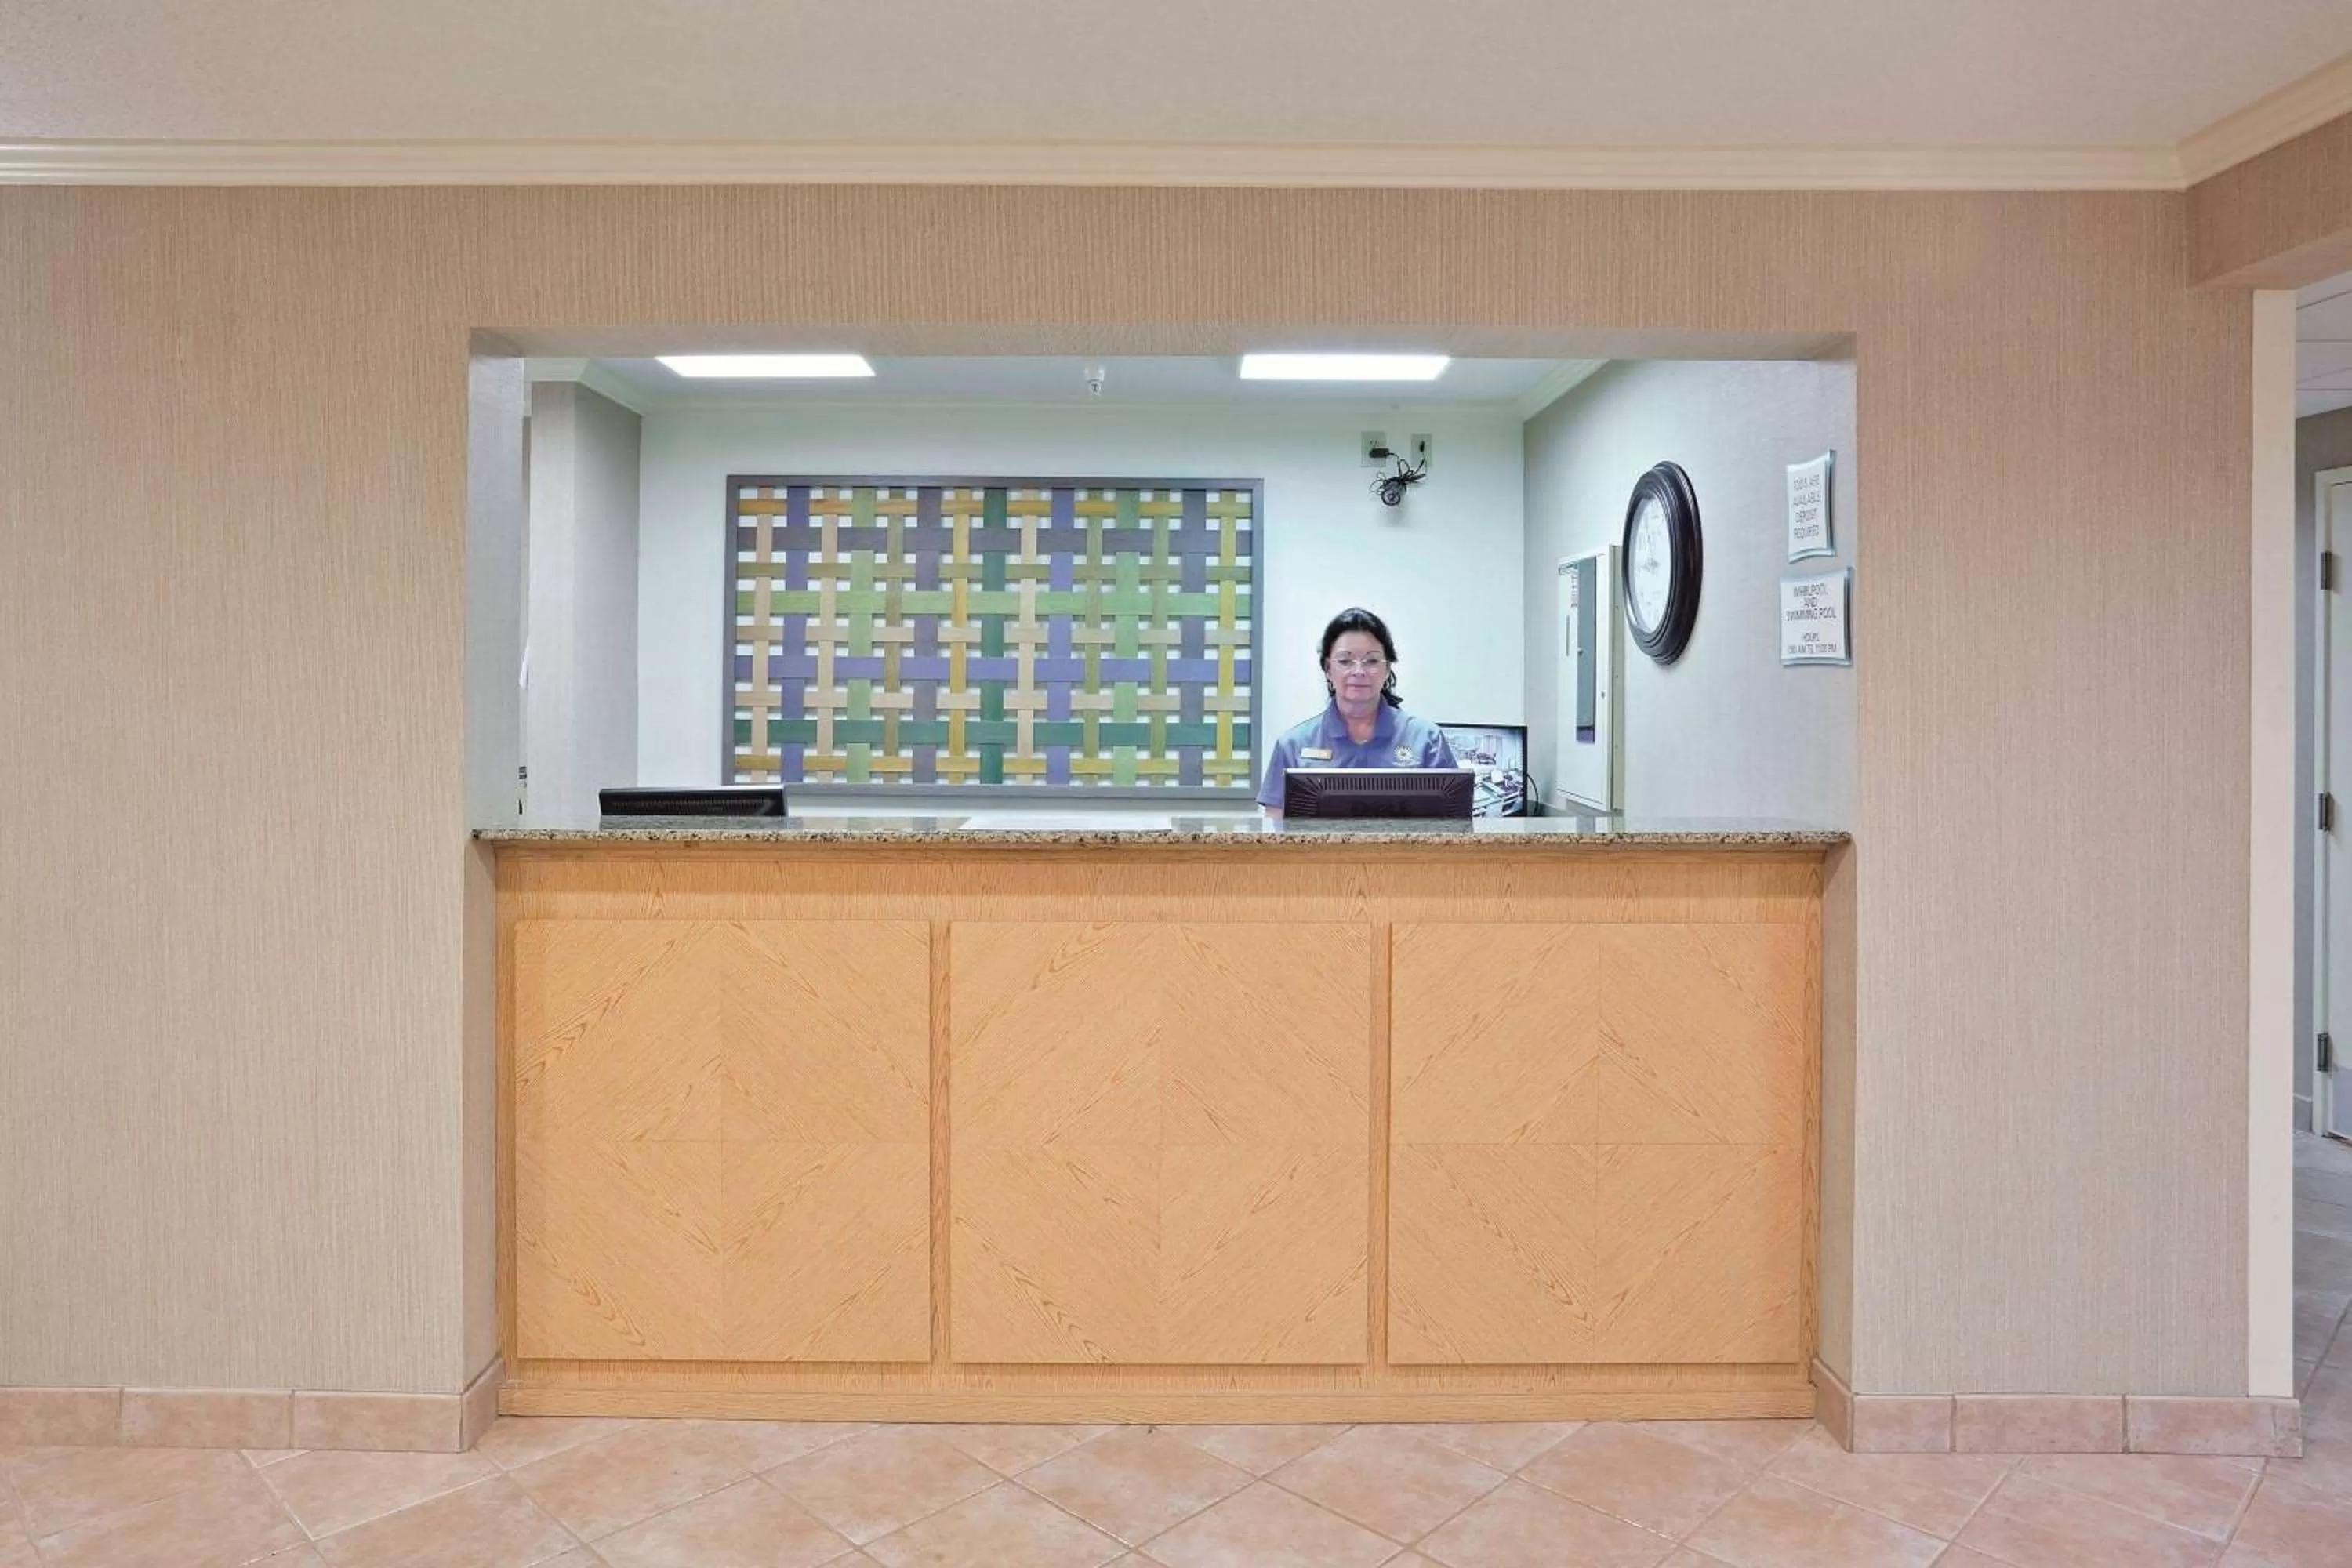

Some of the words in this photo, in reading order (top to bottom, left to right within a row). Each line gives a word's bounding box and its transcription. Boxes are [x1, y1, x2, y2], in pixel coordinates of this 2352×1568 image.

[1795, 508, 1817, 523] DEPOSIT
[1793, 524, 1820, 539] REQUIRED
[1793, 583, 1828, 597] WHIRLPOOL
[1803, 597, 1818, 608] AND
[1785, 608, 1818, 622] SWIMMING
[1819, 606, 1837, 619] POOL
